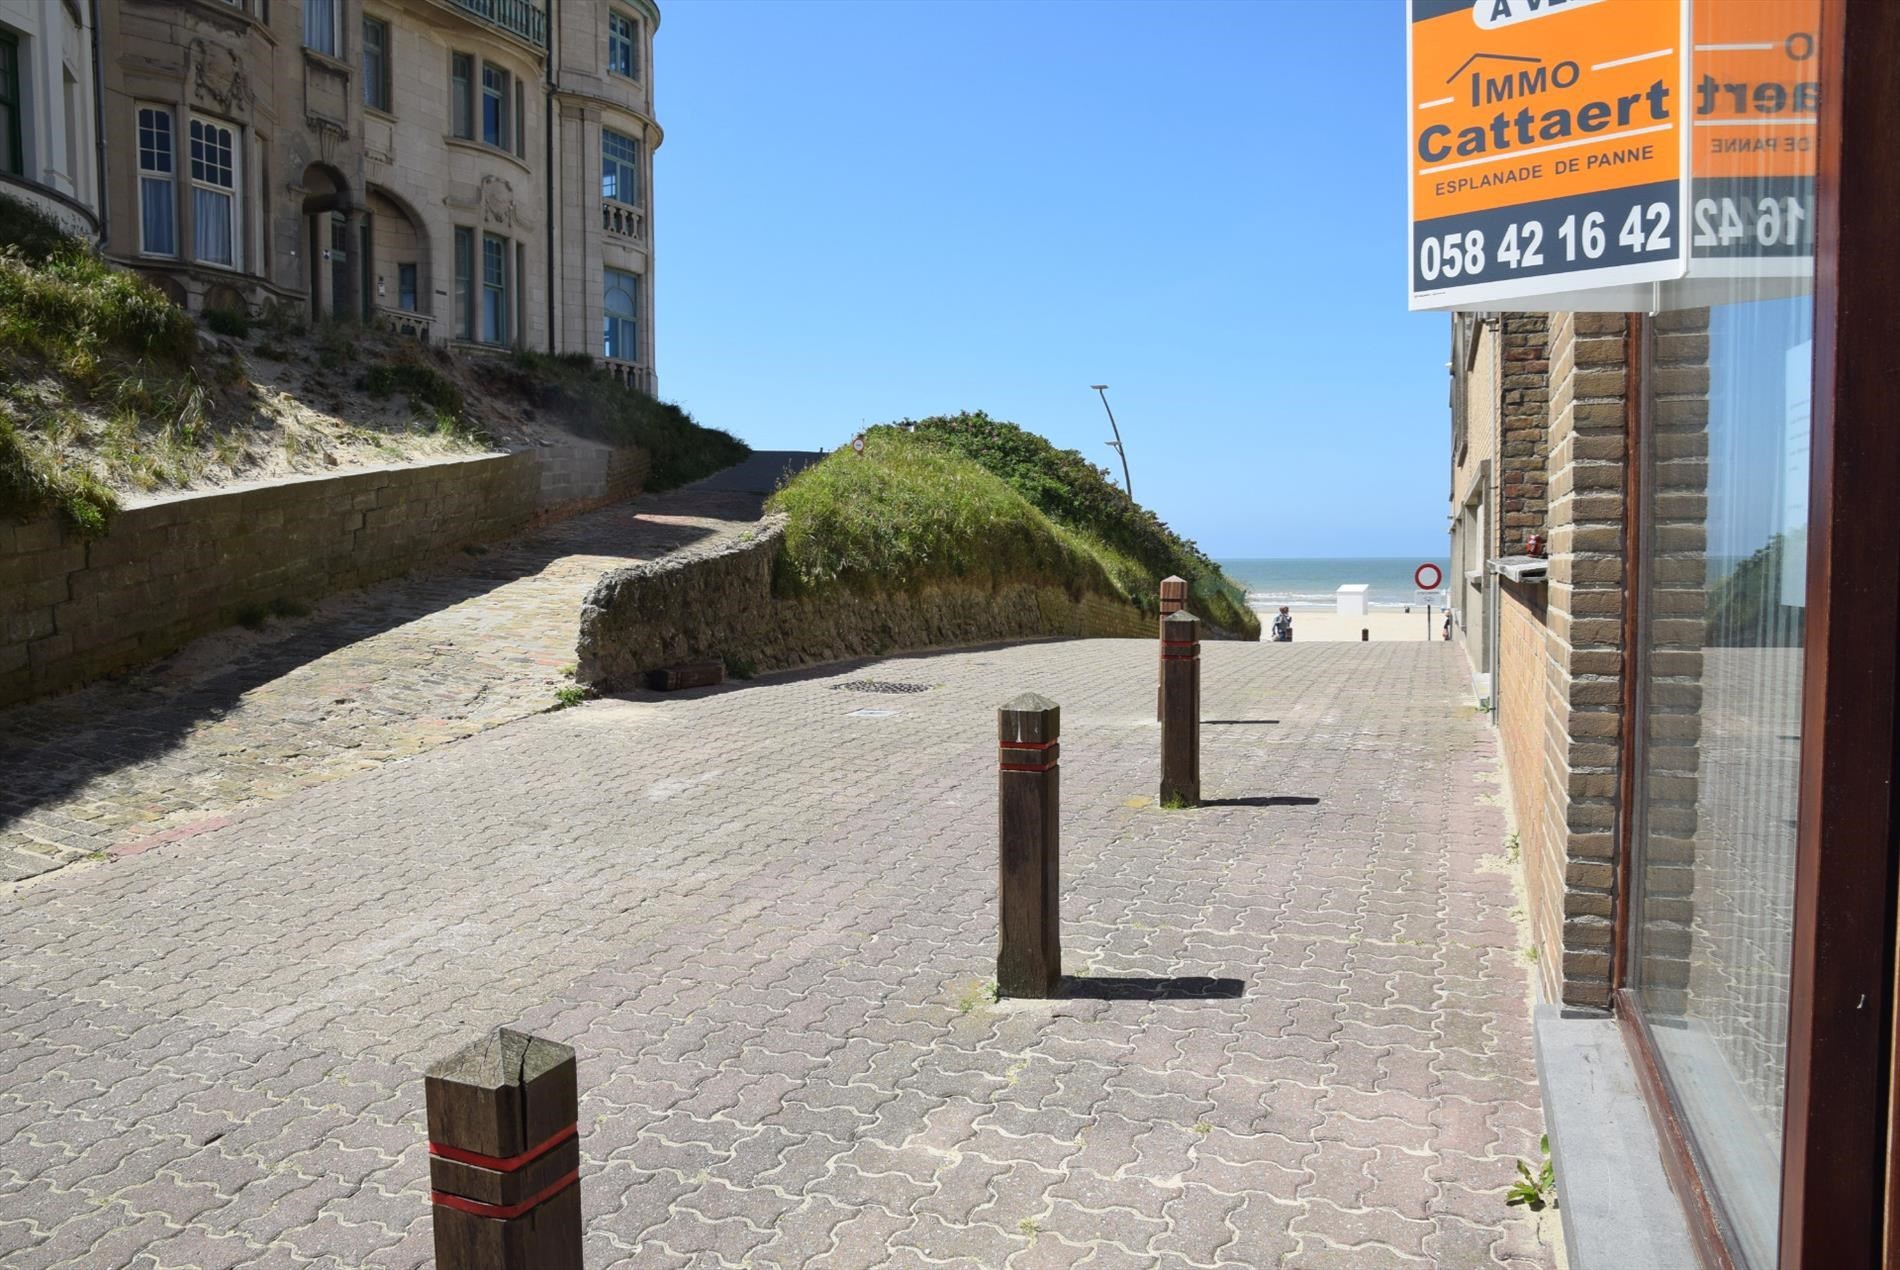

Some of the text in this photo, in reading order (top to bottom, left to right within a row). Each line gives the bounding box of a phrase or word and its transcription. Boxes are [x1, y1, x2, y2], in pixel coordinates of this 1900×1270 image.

[1471, 60, 1580, 107] IMMO
[1418, 79, 1670, 164] Cattaert
[1435, 145, 1654, 196] ESPLANADE DE PANNE
[1420, 202, 1671, 281] 058 42 16 42
